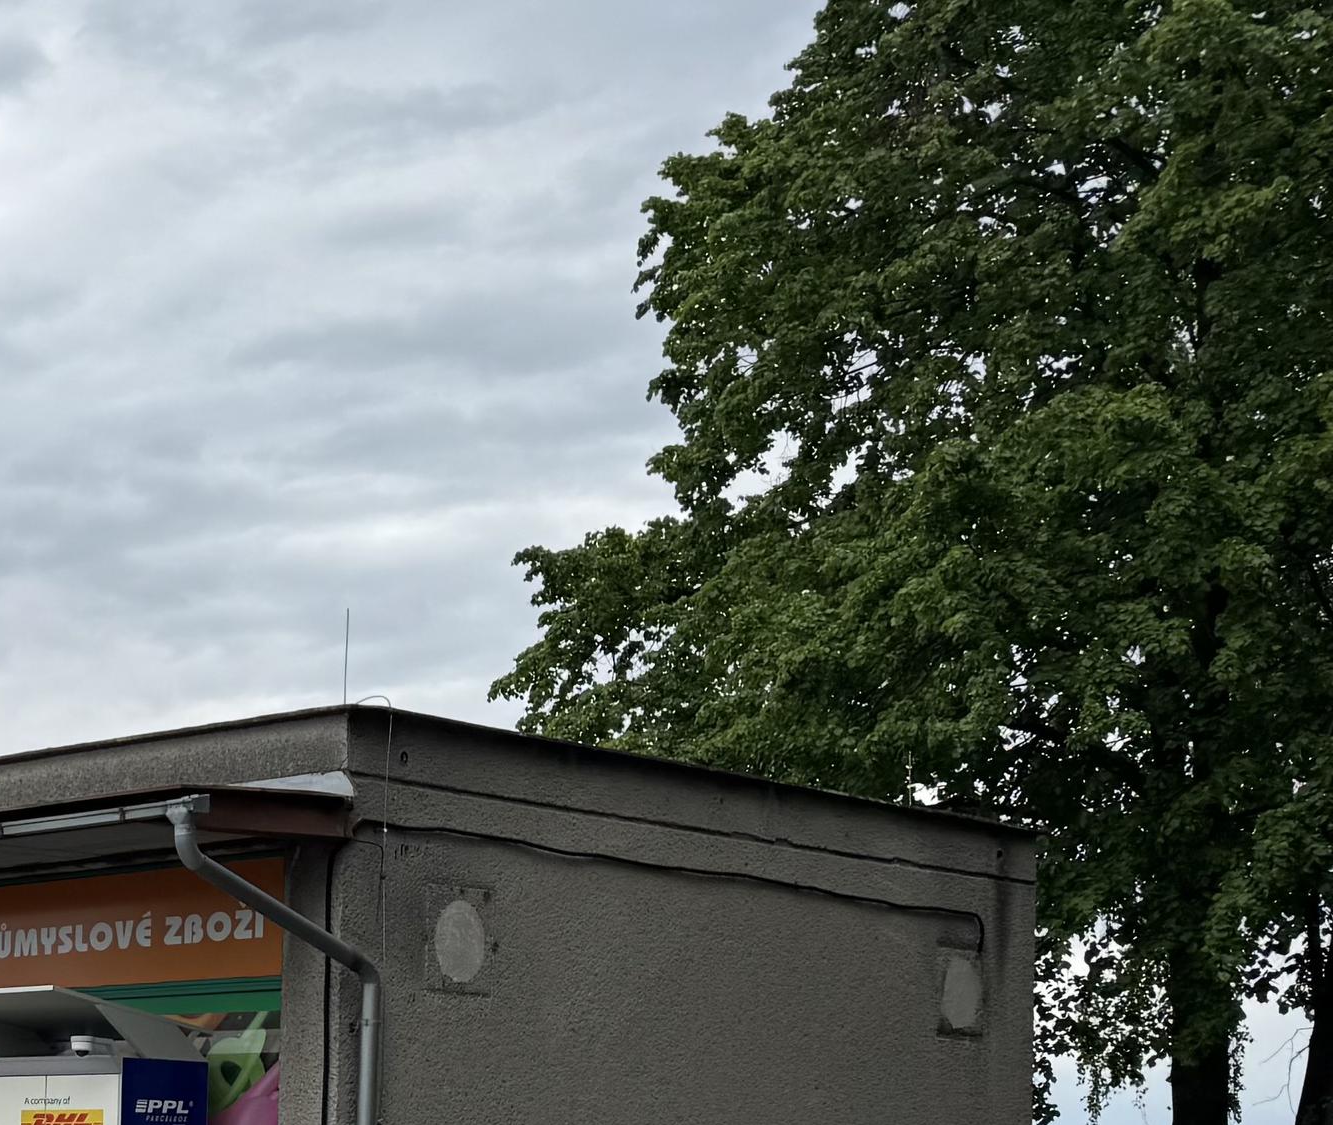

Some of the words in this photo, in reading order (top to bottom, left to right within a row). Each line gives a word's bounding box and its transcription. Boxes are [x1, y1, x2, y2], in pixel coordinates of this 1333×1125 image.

[30, 1097, 62, 1107] company
[62, 1096, 71, 1105] of
[147, 1100, 189, 1114] PPL
